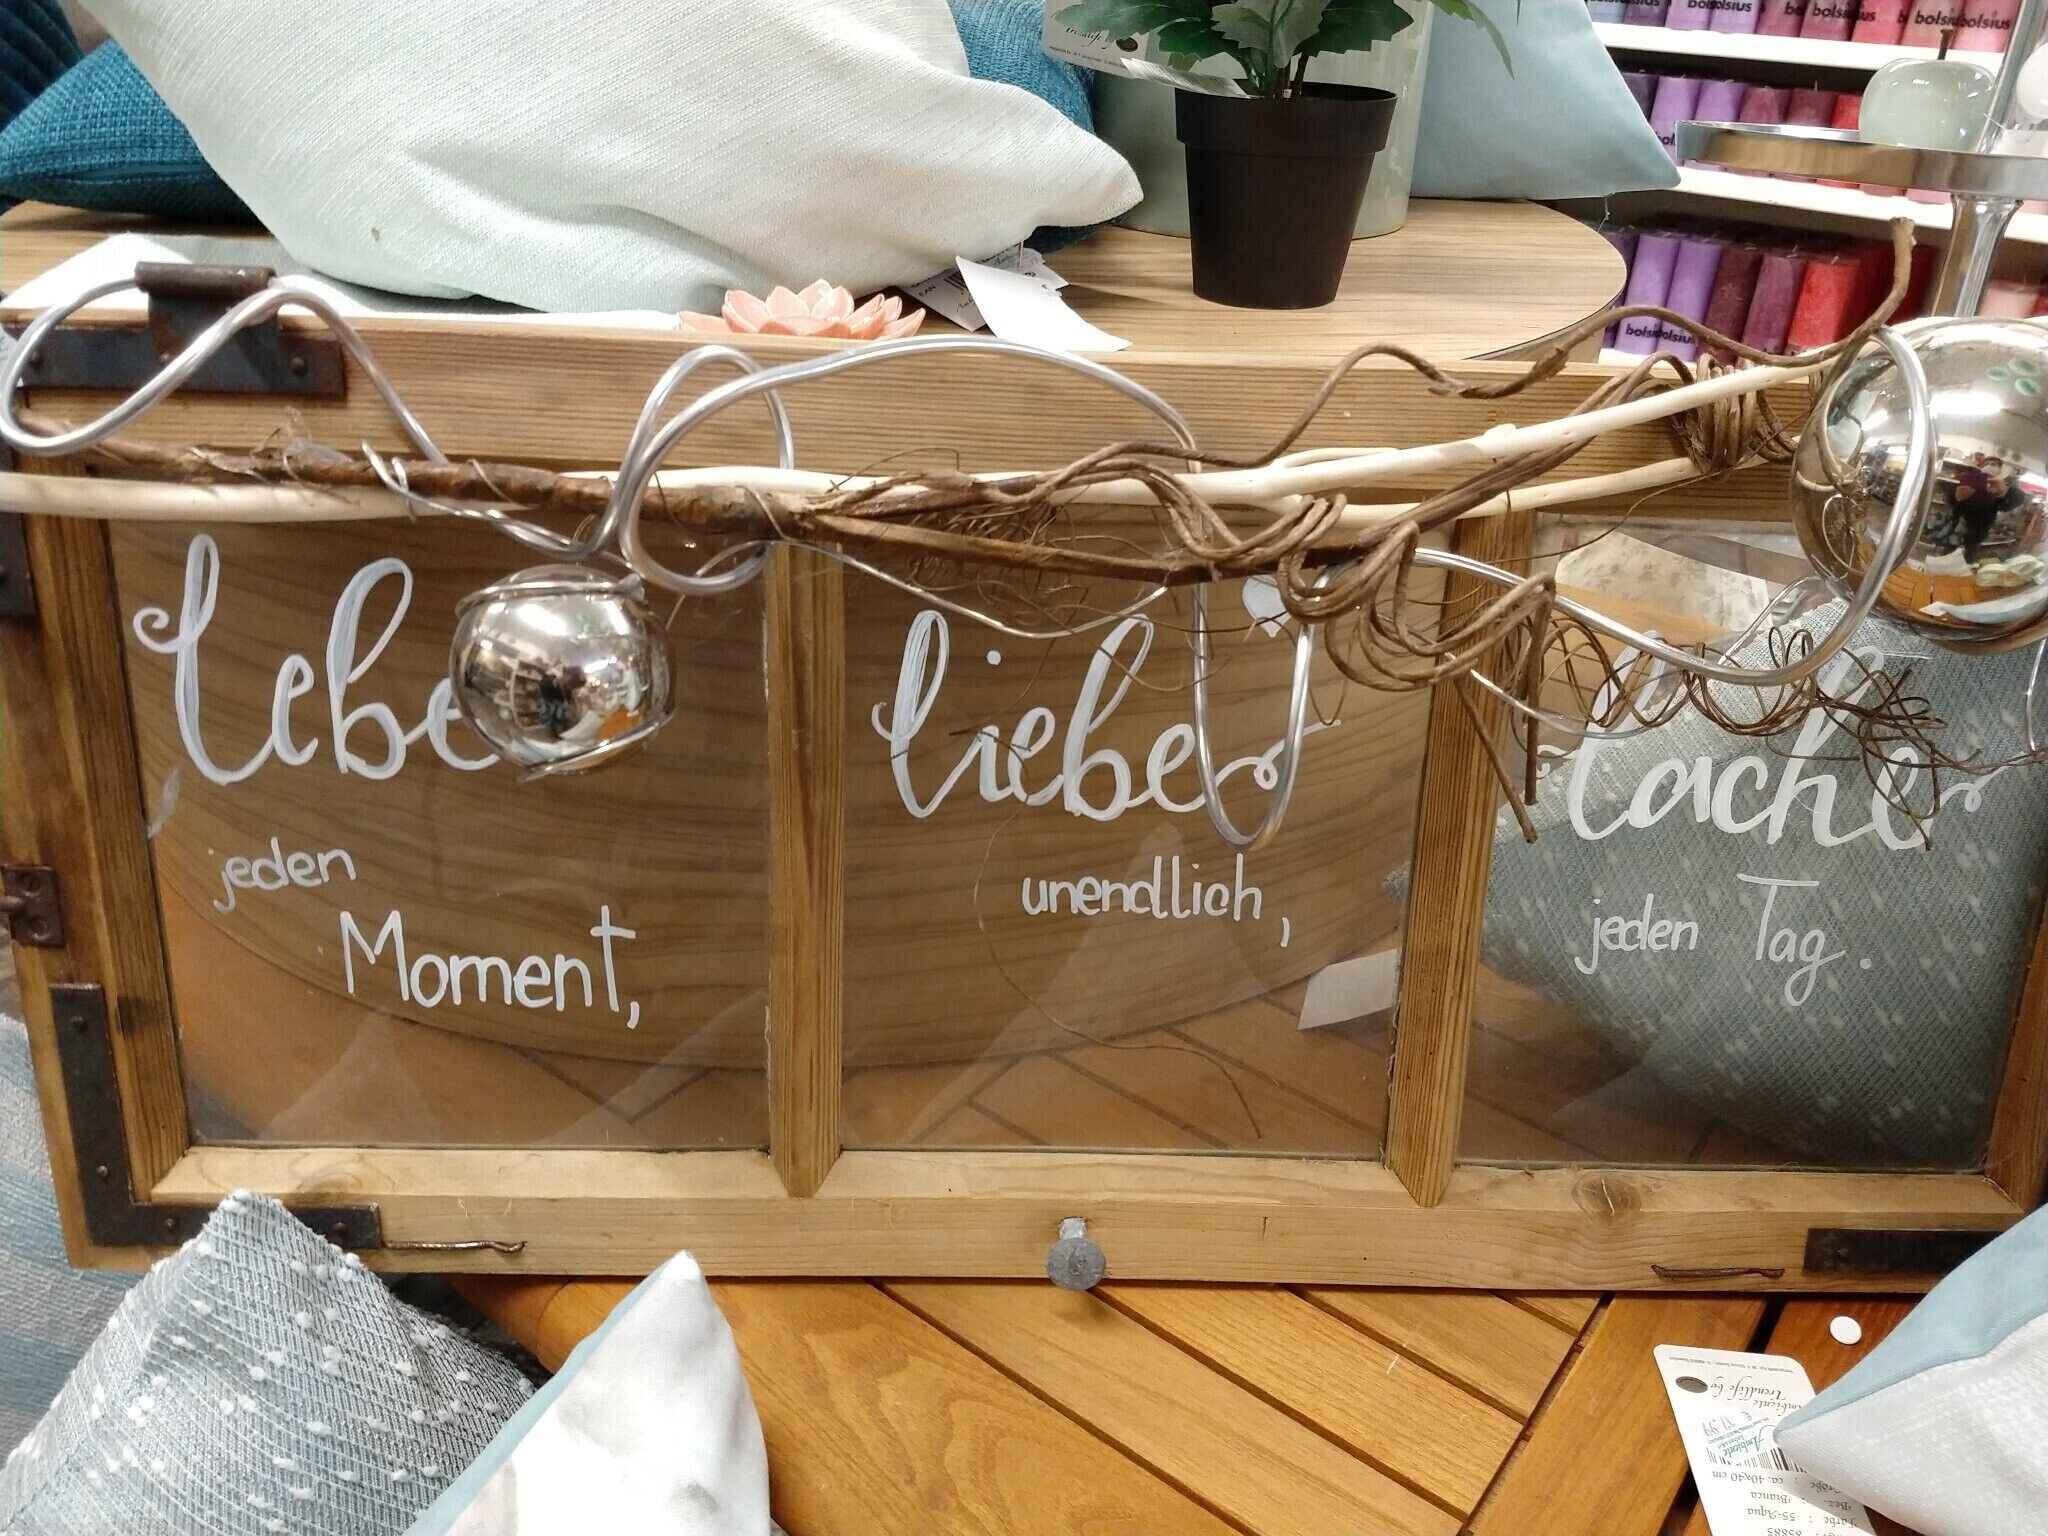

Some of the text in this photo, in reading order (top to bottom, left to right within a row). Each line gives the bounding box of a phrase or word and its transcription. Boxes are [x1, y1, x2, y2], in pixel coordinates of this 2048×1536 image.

[214, 837, 356, 913] jeden
[1574, 893, 1698, 976] jeden
[340, 905, 640, 1030] Moment,
[1709, 1376, 1724, 1398] by
[1753, 1399, 1801, 1417] mbiente
[1711, 1471, 1728, 1479] cm
[1730, 1472, 1765, 1486] 40x40
[1767, 1476, 1784, 1485] ca.
[1750, 1492, 1851, 1511] Bez. Bianca
[1747, 1505, 1796, 1521] 55-Aqua
